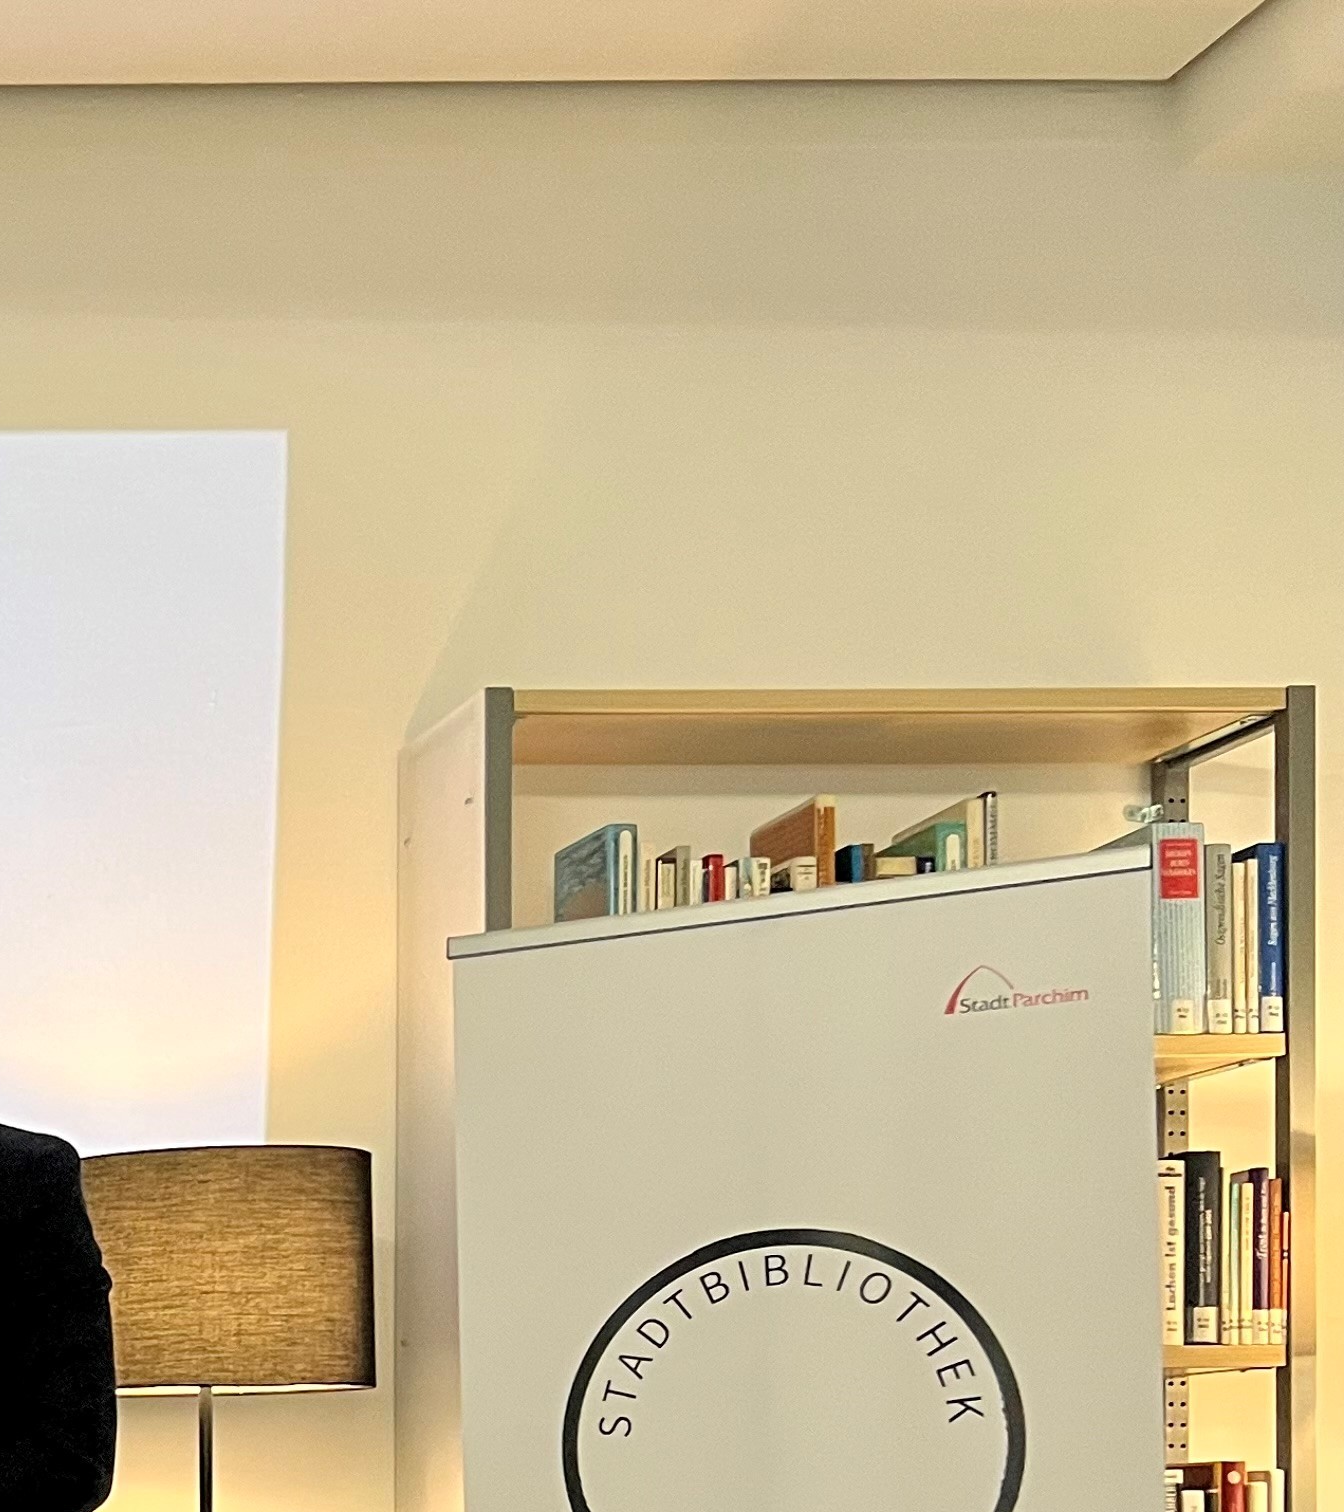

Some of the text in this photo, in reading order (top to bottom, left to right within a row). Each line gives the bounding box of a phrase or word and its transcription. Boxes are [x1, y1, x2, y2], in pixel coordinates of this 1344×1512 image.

[959, 989, 1089, 1013] Stadt Parchim
[1164, 1186, 1179, 1236] gesund
[1164, 1262, 1177, 1310] Lachen
[598, 1253, 985, 1437] STADTBIBLIOTHEK
